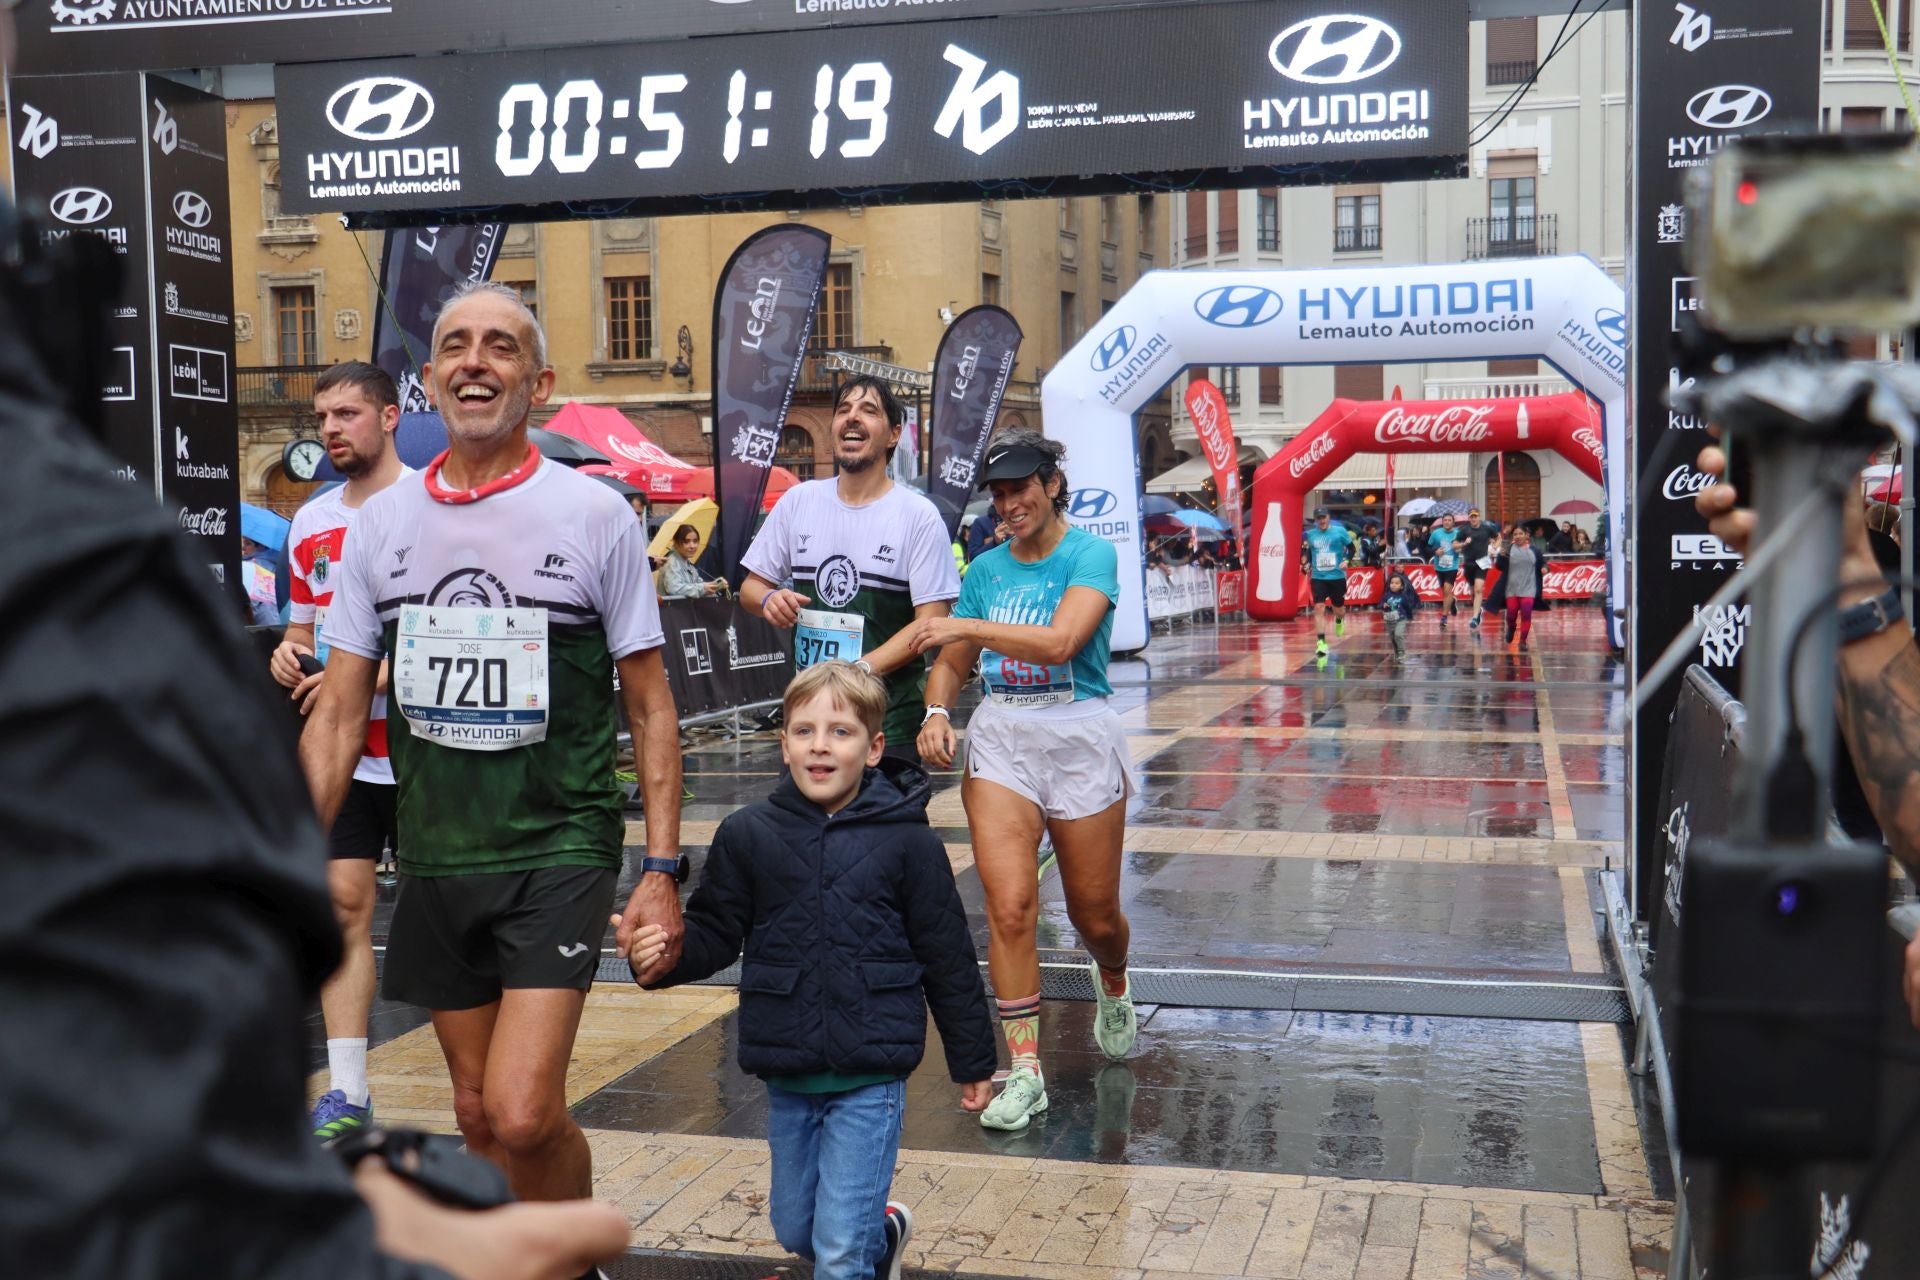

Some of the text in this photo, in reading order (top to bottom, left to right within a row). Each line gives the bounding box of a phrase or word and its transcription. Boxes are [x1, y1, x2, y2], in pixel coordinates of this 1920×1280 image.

[124, 0, 291, 19] AYUNTAMIENTO
[1243, 89, 1429, 130] HYUNDAI
[1244, 124, 1429, 149] Lemauto Automoción
[307, 145, 460, 181] HYUNDAI
[1668, 157, 1710, 168] Lemaut
[309, 177, 460, 198] Lemauto Automoción
[166, 226, 221, 253] HYUNDAI
[120, 307, 137, 315] LEÓN
[1299, 278, 1534, 321] HYUNDAI
[1299, 314, 1534, 340] Lemauto Automoción
[1557, 330, 1586, 357] Lemauto
[174, 362, 197, 380] LEÓN
[1099, 332, 1167, 400] HYUNDAI
[1110, 343, 1173, 405] Lemauto Automoción
[973, 390, 999, 461] AYUNTAMIENTO
[995, 374, 1004, 390] DE
[1374, 405, 1495, 444] Coca-Cola
[176, 461, 229, 480] kutxabank
[534, 569, 576, 583] MARCET
[1671, 562, 1745, 571] PLAZ
[429, 627, 463, 635] kutxabank
[457, 643, 482, 654] JOSE
[800, 637, 839, 665] 379
[429, 656, 508, 708] 720
[1001, 657, 1050, 685] 653
[1016, 694, 1059, 703] HYUNDAI
[451, 726, 520, 739] HYUNDAI
